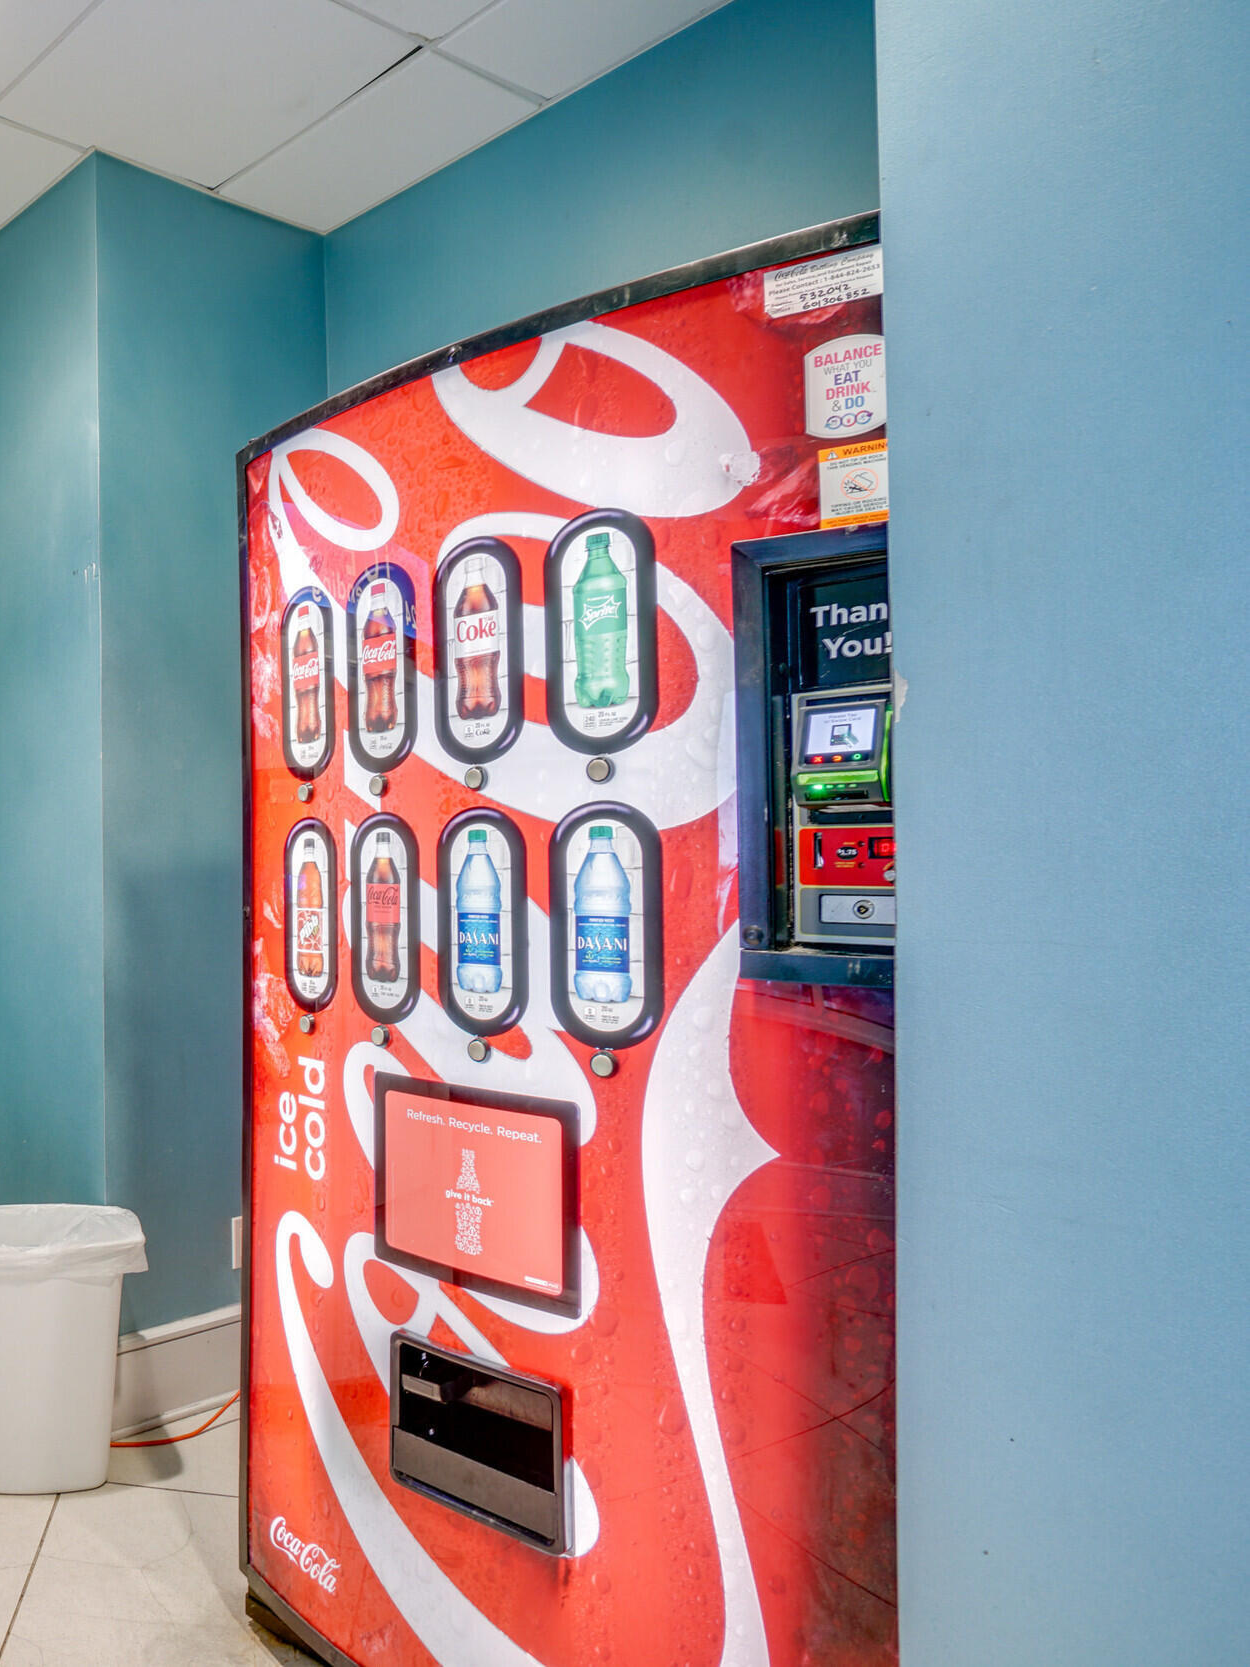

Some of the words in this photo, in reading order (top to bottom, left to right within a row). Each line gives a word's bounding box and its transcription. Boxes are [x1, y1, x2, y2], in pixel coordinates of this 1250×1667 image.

[799, 283, 852, 302] 532042
[814, 343, 882, 368] BALANCE
[823, 362, 850, 376] WHAT
[853, 359, 872, 370] YOU
[834, 369, 861, 386] EAT
[825, 380, 871, 401] DRINK
[832, 399, 842, 412] &
[844, 395, 865, 409] DO
[842, 442, 888, 456] WARNIN
[810, 602, 888, 628] Than
[456, 617, 497, 643] Coke
[362, 640, 396, 665] Coca-Cola
[821, 631, 893, 660] You!
[459, 927, 499, 946] DASANI
[577, 932, 627, 952] DASANI
[297, 1055, 326, 1181] cold
[406, 1108, 446, 1126] Refresh.
[448, 1117, 494, 1135] Recycle.
[496, 1125, 543, 1144] Repeat.
[273, 1091, 297, 1171] ice
[445, 1189, 462, 1199] give
[463, 1191, 471, 1201] it
[270, 1515, 342, 1593] Coca-Cola
